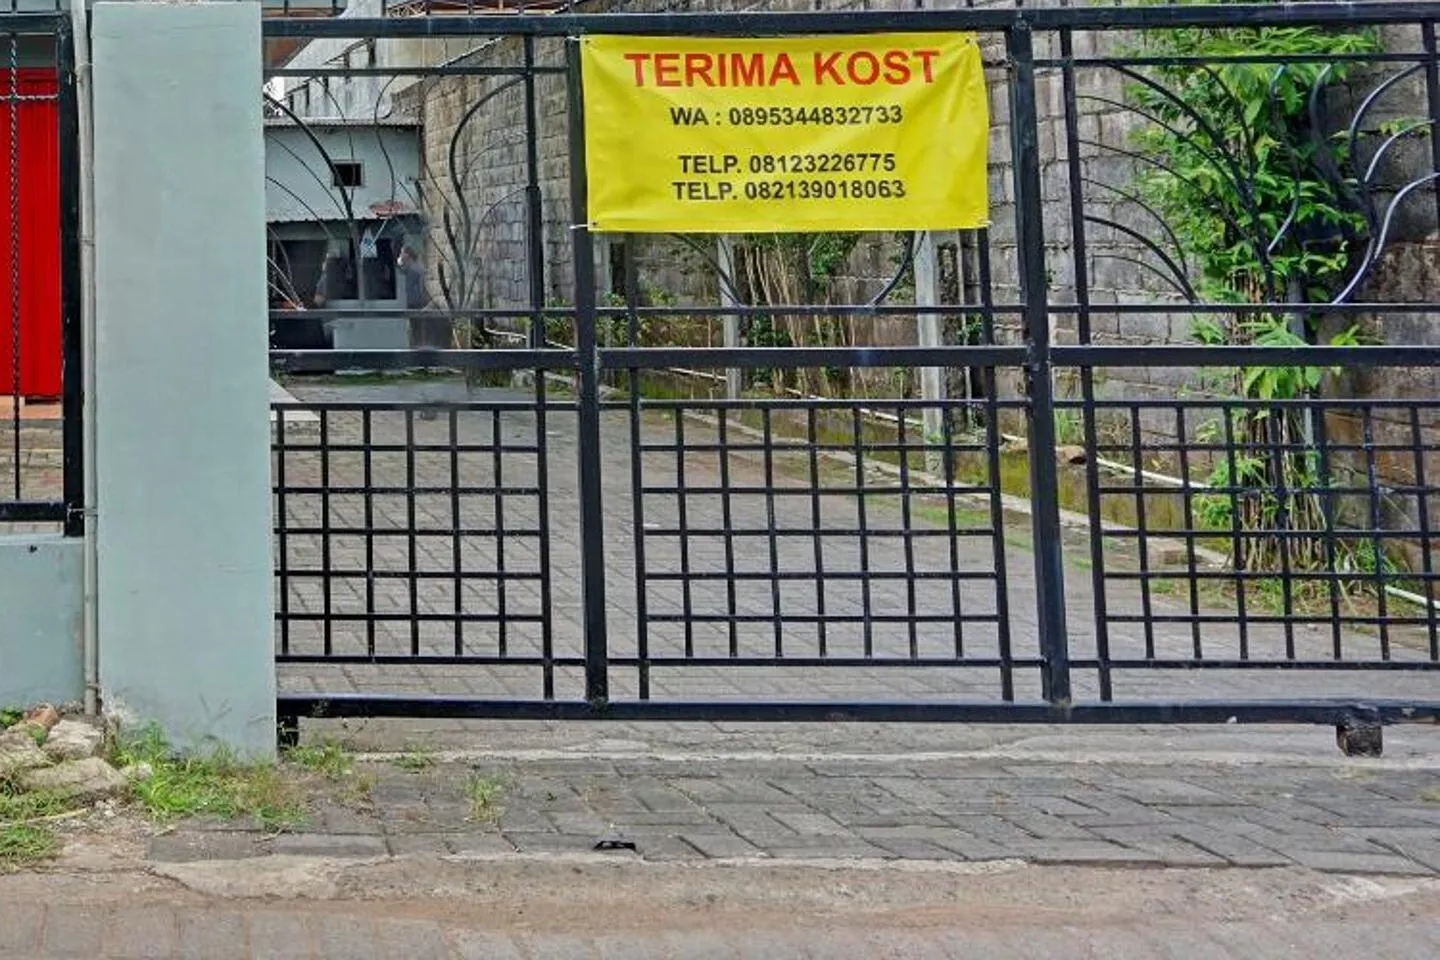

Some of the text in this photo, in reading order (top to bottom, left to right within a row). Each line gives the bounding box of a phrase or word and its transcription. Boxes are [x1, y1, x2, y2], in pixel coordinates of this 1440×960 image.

[625, 50, 940, 87] TERIMA KOST
[670, 107, 709, 126] WA
[729, 105, 903, 126] 0895344832733
[678, 153, 896, 174] TELP. 08123226775
[672, 179, 906, 201] TELP. 082139018063
